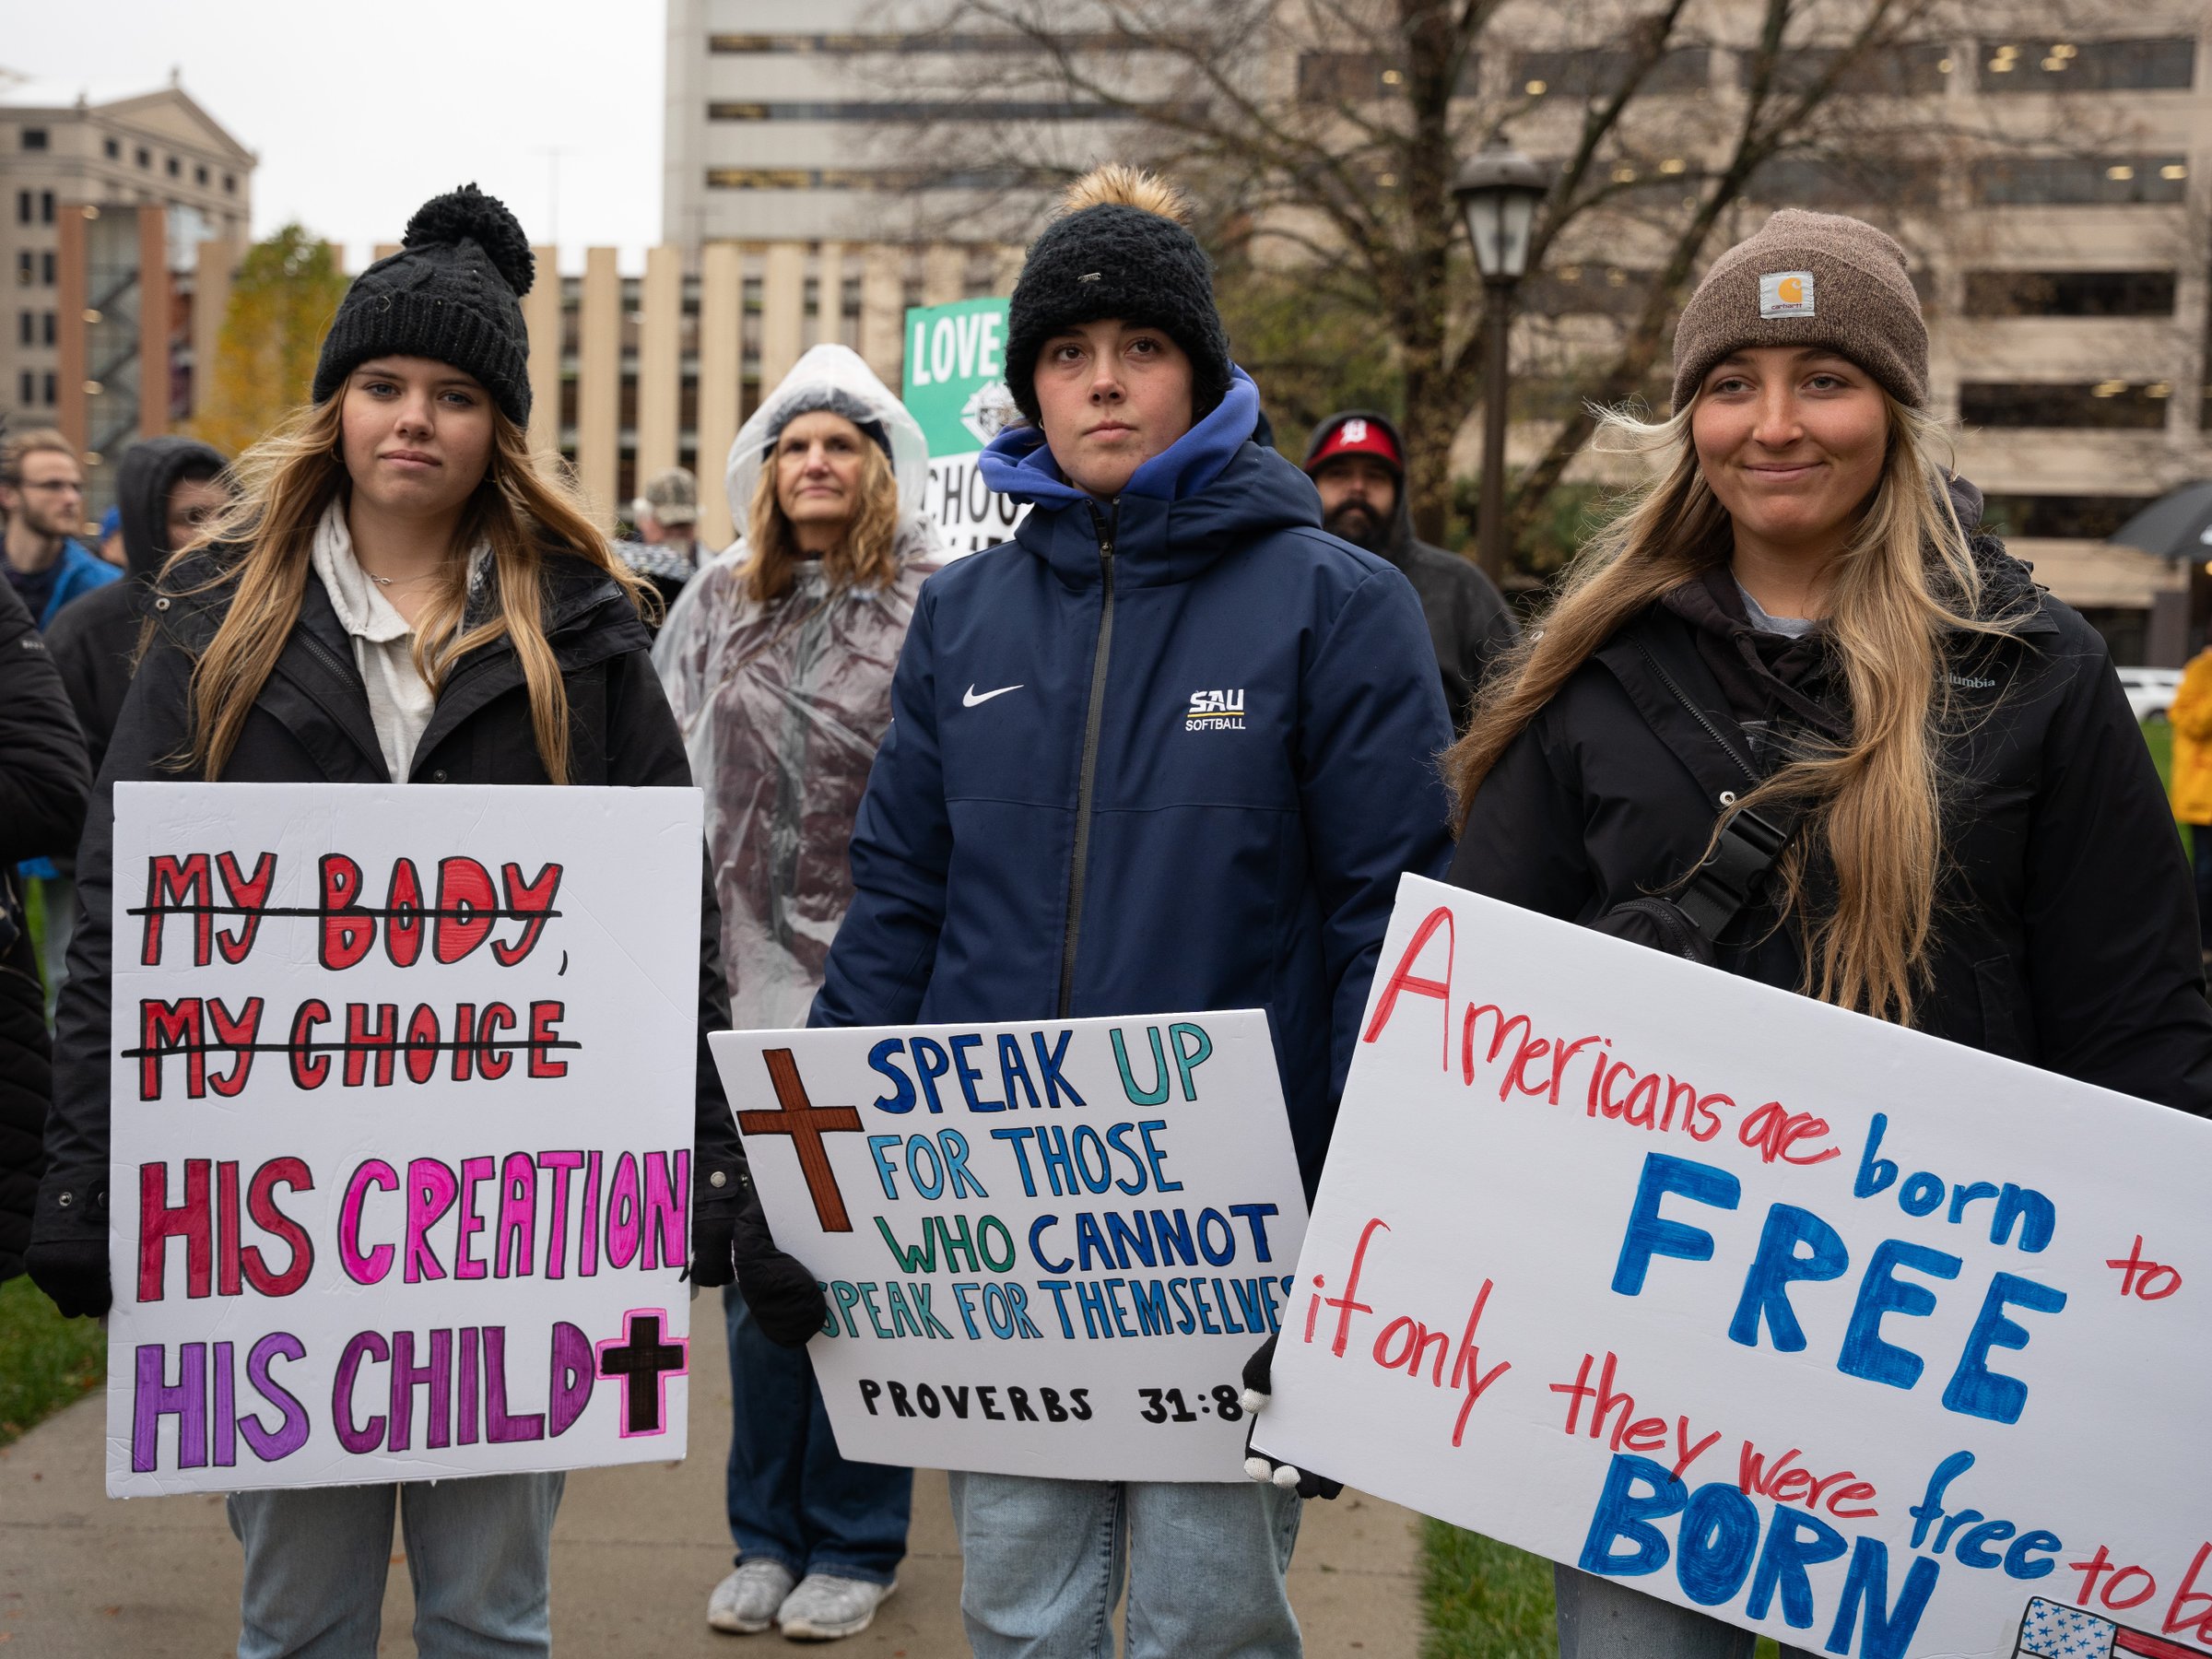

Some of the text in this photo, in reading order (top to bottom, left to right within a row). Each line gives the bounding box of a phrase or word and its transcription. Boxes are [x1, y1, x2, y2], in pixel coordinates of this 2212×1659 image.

[912, 312, 1002, 385] LOVE
[1185, 718, 1246, 731] SOFTBALL
[1189, 689, 1244, 712] SAU
[141, 851, 278, 967] MY
[139, 996, 569, 1101] MY CHOICE
[867, 1023, 1213, 1113] SPEAK UP
[1363, 906, 2183, 1300] Americans are born to
[867, 1120, 1184, 1201] FOR THOSE
[136, 1157, 315, 1302] HIS
[874, 1204, 1279, 1274] WHO CANNOT
[952, 1282, 1043, 1341] FOR
[1610, 1151, 2068, 1424] FREE
[132, 1322, 595, 1473] HIS CHILD
[859, 1379, 1243, 1424] PROVERBS 31:8
[1304, 1218, 1392, 1358] if
[1372, 1277, 1512, 1448] only
[1549, 1351, 1722, 1483] they
[1738, 1440, 1879, 1519] were
[1909, 1450, 2063, 1580] free
[2069, 1545, 2157, 1611] to
[1578, 1453, 1941, 1659] BORN
